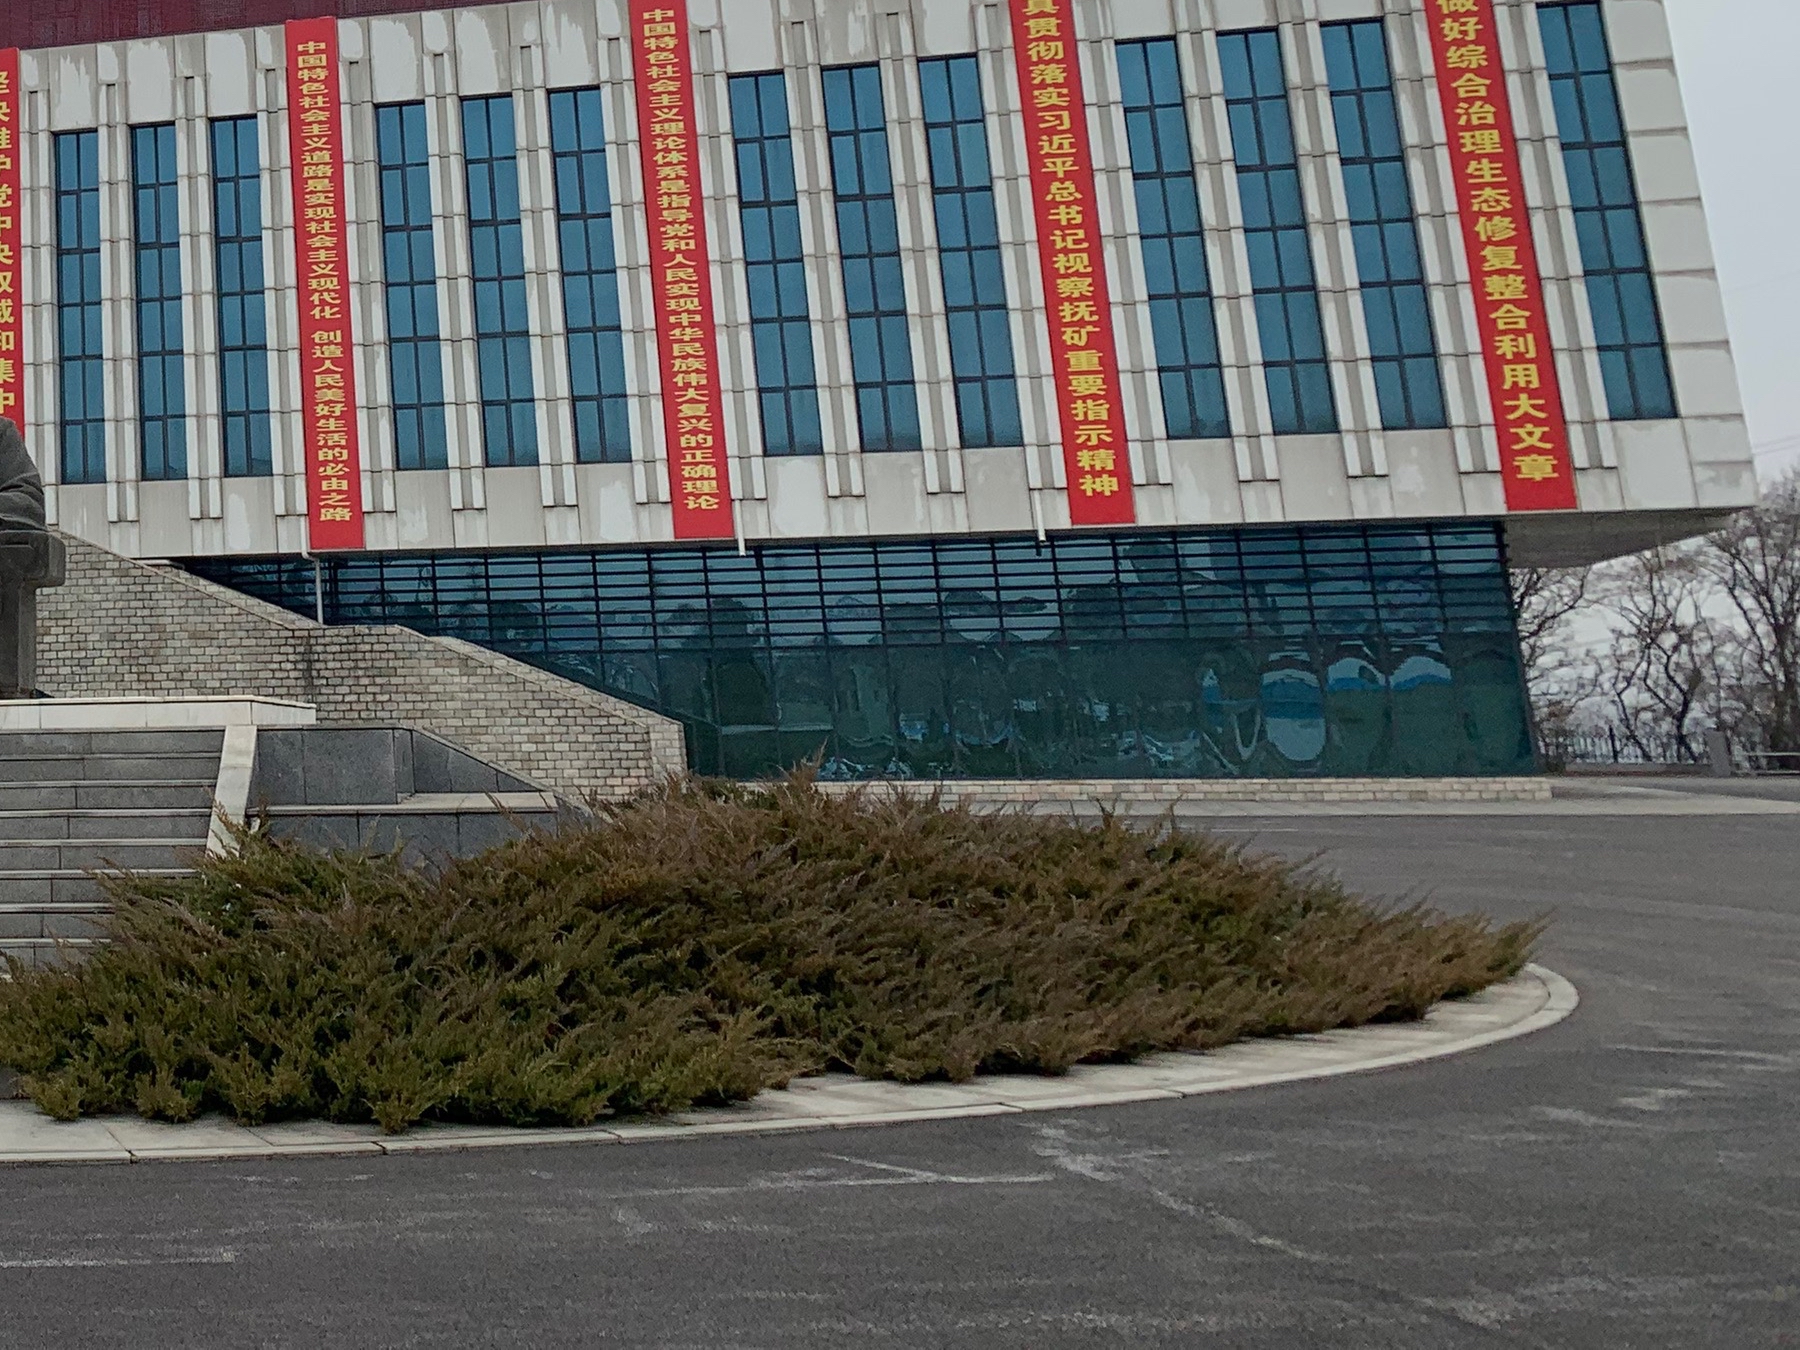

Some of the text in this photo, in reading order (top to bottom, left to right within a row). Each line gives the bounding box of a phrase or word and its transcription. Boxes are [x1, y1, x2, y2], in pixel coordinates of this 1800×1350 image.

[297, 41, 353, 522] 中国特色社会主义道路是实现社会主义现代化 创造人民美好生活的必由之路
[643, 9, 720, 511] 中国特色社会主义理论体系是指导党和人民实现中华民族伟大复兴的正确理论
